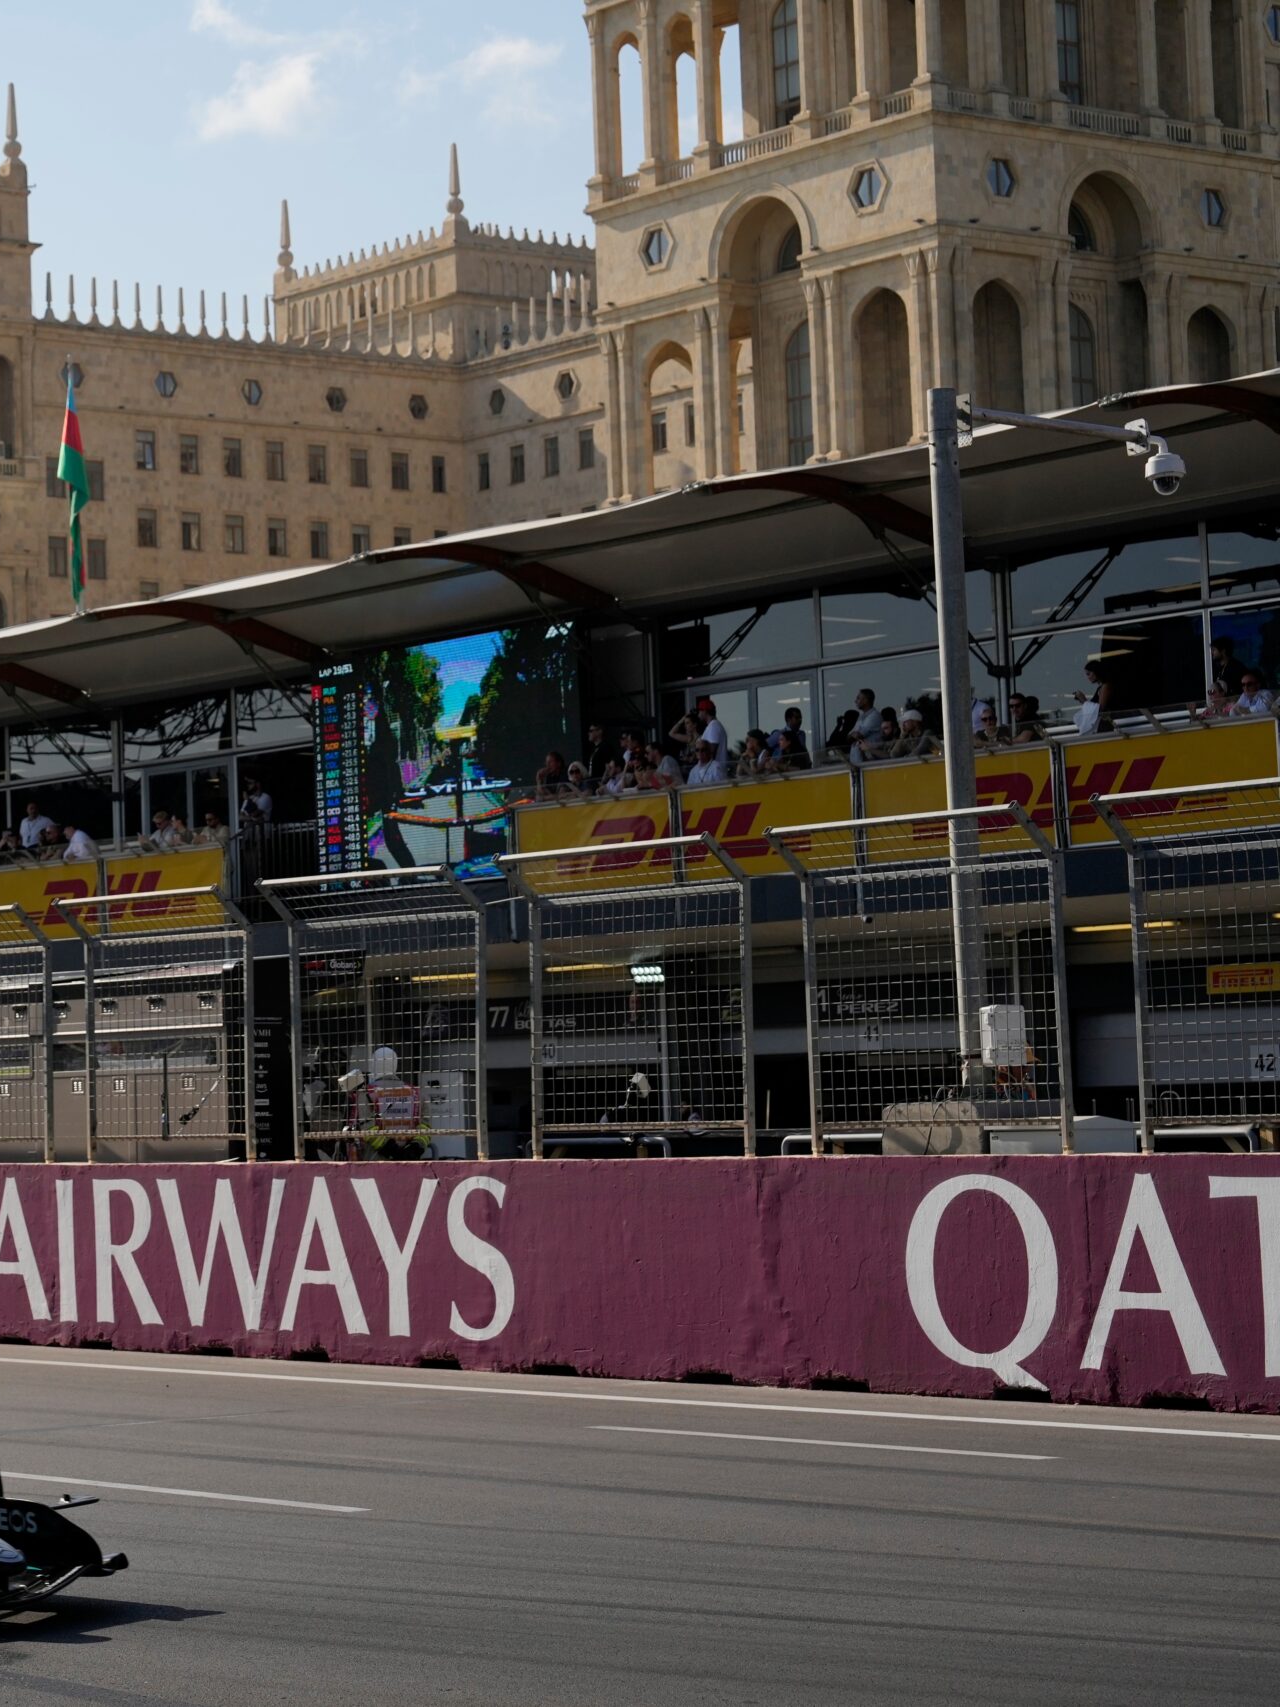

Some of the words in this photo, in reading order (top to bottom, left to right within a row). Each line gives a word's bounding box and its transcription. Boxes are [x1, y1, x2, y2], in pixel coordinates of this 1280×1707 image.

[318, 667, 332, 678] LAP
[968, 756, 1180, 832] DHL
[582, 802, 772, 874] DHL
[40, 870, 176, 924] DHL
[330, 959, 357, 969] Globant
[1213, 969, 1274, 988] PIRELLI
[836, 1002, 899, 1014] PEREZ
[488, 1006, 510, 1029] 77
[514, 1017, 577, 1030] BOTAS
[253, 1028, 271, 1037] VMH
[864, 1025, 879, 1042] 41
[542, 1043, 556, 1059] 40
[1254, 1053, 1277, 1072] 42
[905, 1173, 1280, 1392] QAT
